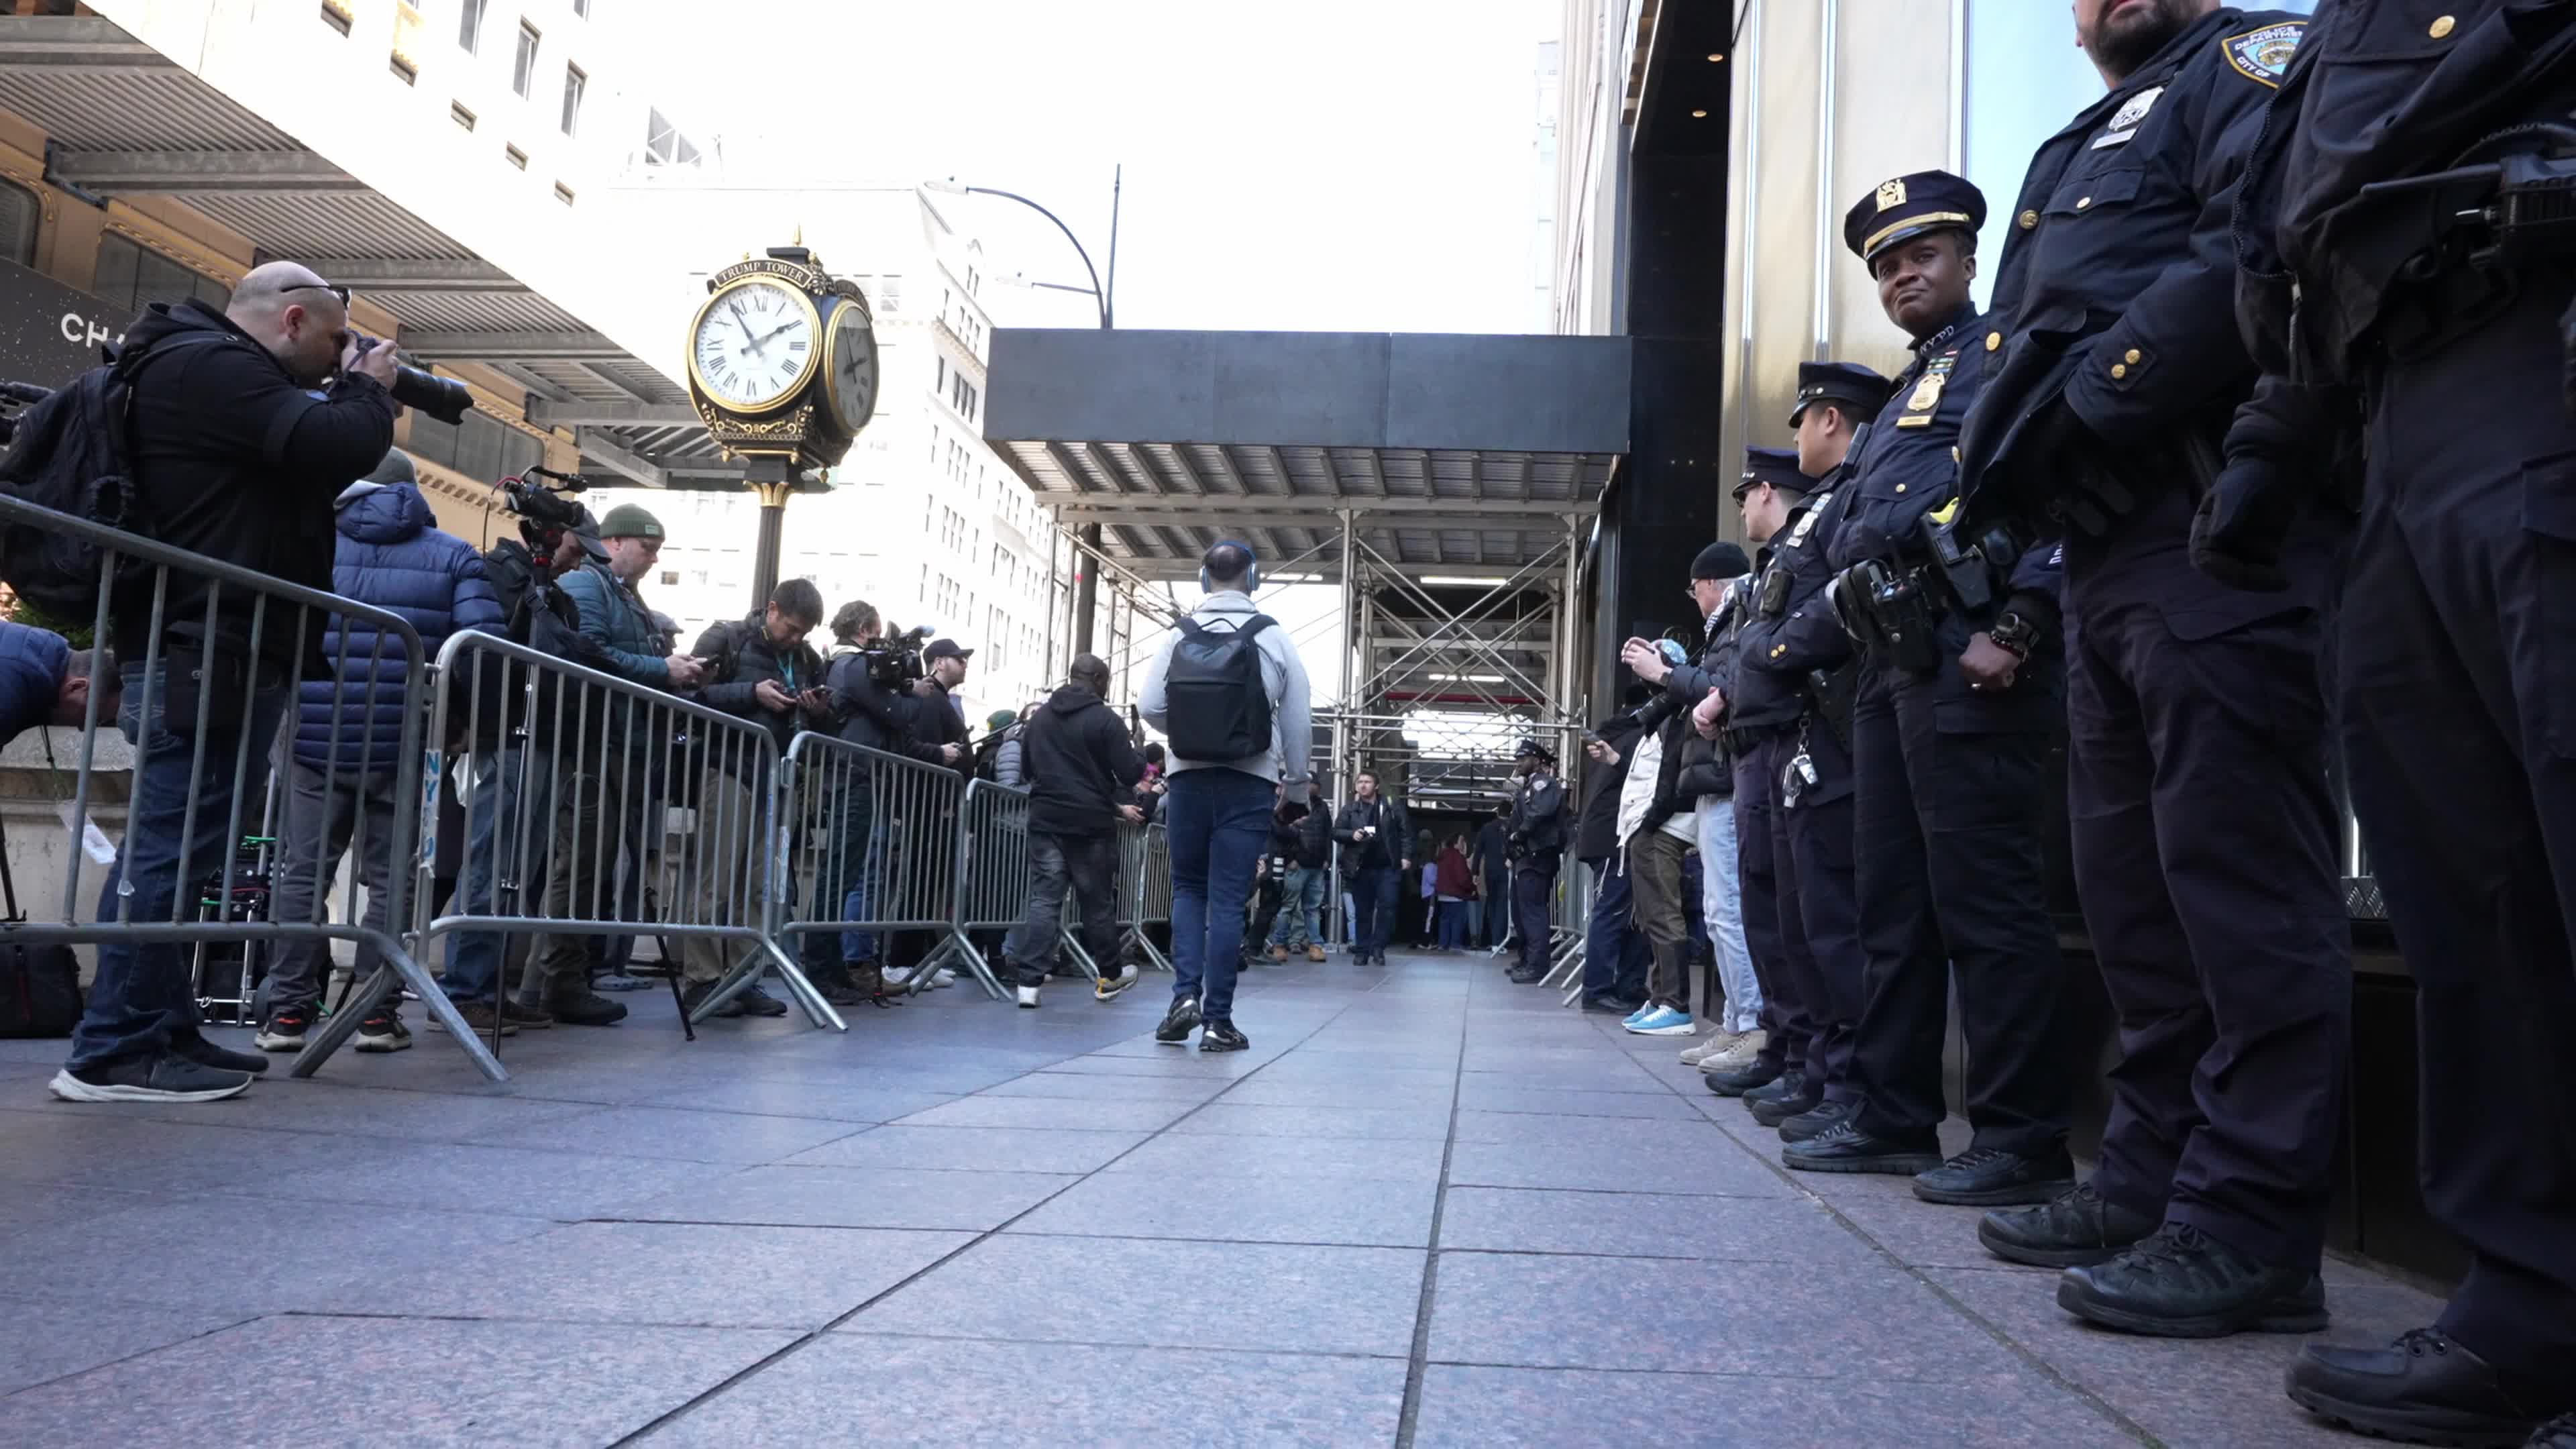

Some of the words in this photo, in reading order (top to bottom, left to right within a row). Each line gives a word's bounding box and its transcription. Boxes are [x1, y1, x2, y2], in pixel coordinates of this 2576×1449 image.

[2249, 26, 2296, 40] POLICE
[2237, 56, 2257, 71] CITY
[2255, 69, 2271, 78] OF
[718, 262, 761, 281] TRUMP
[765, 262, 804, 281] TOWER
[61, 313, 125, 347] CH
[1920, 325, 1953, 355] NYPD
[423, 751, 440, 859] NYD
